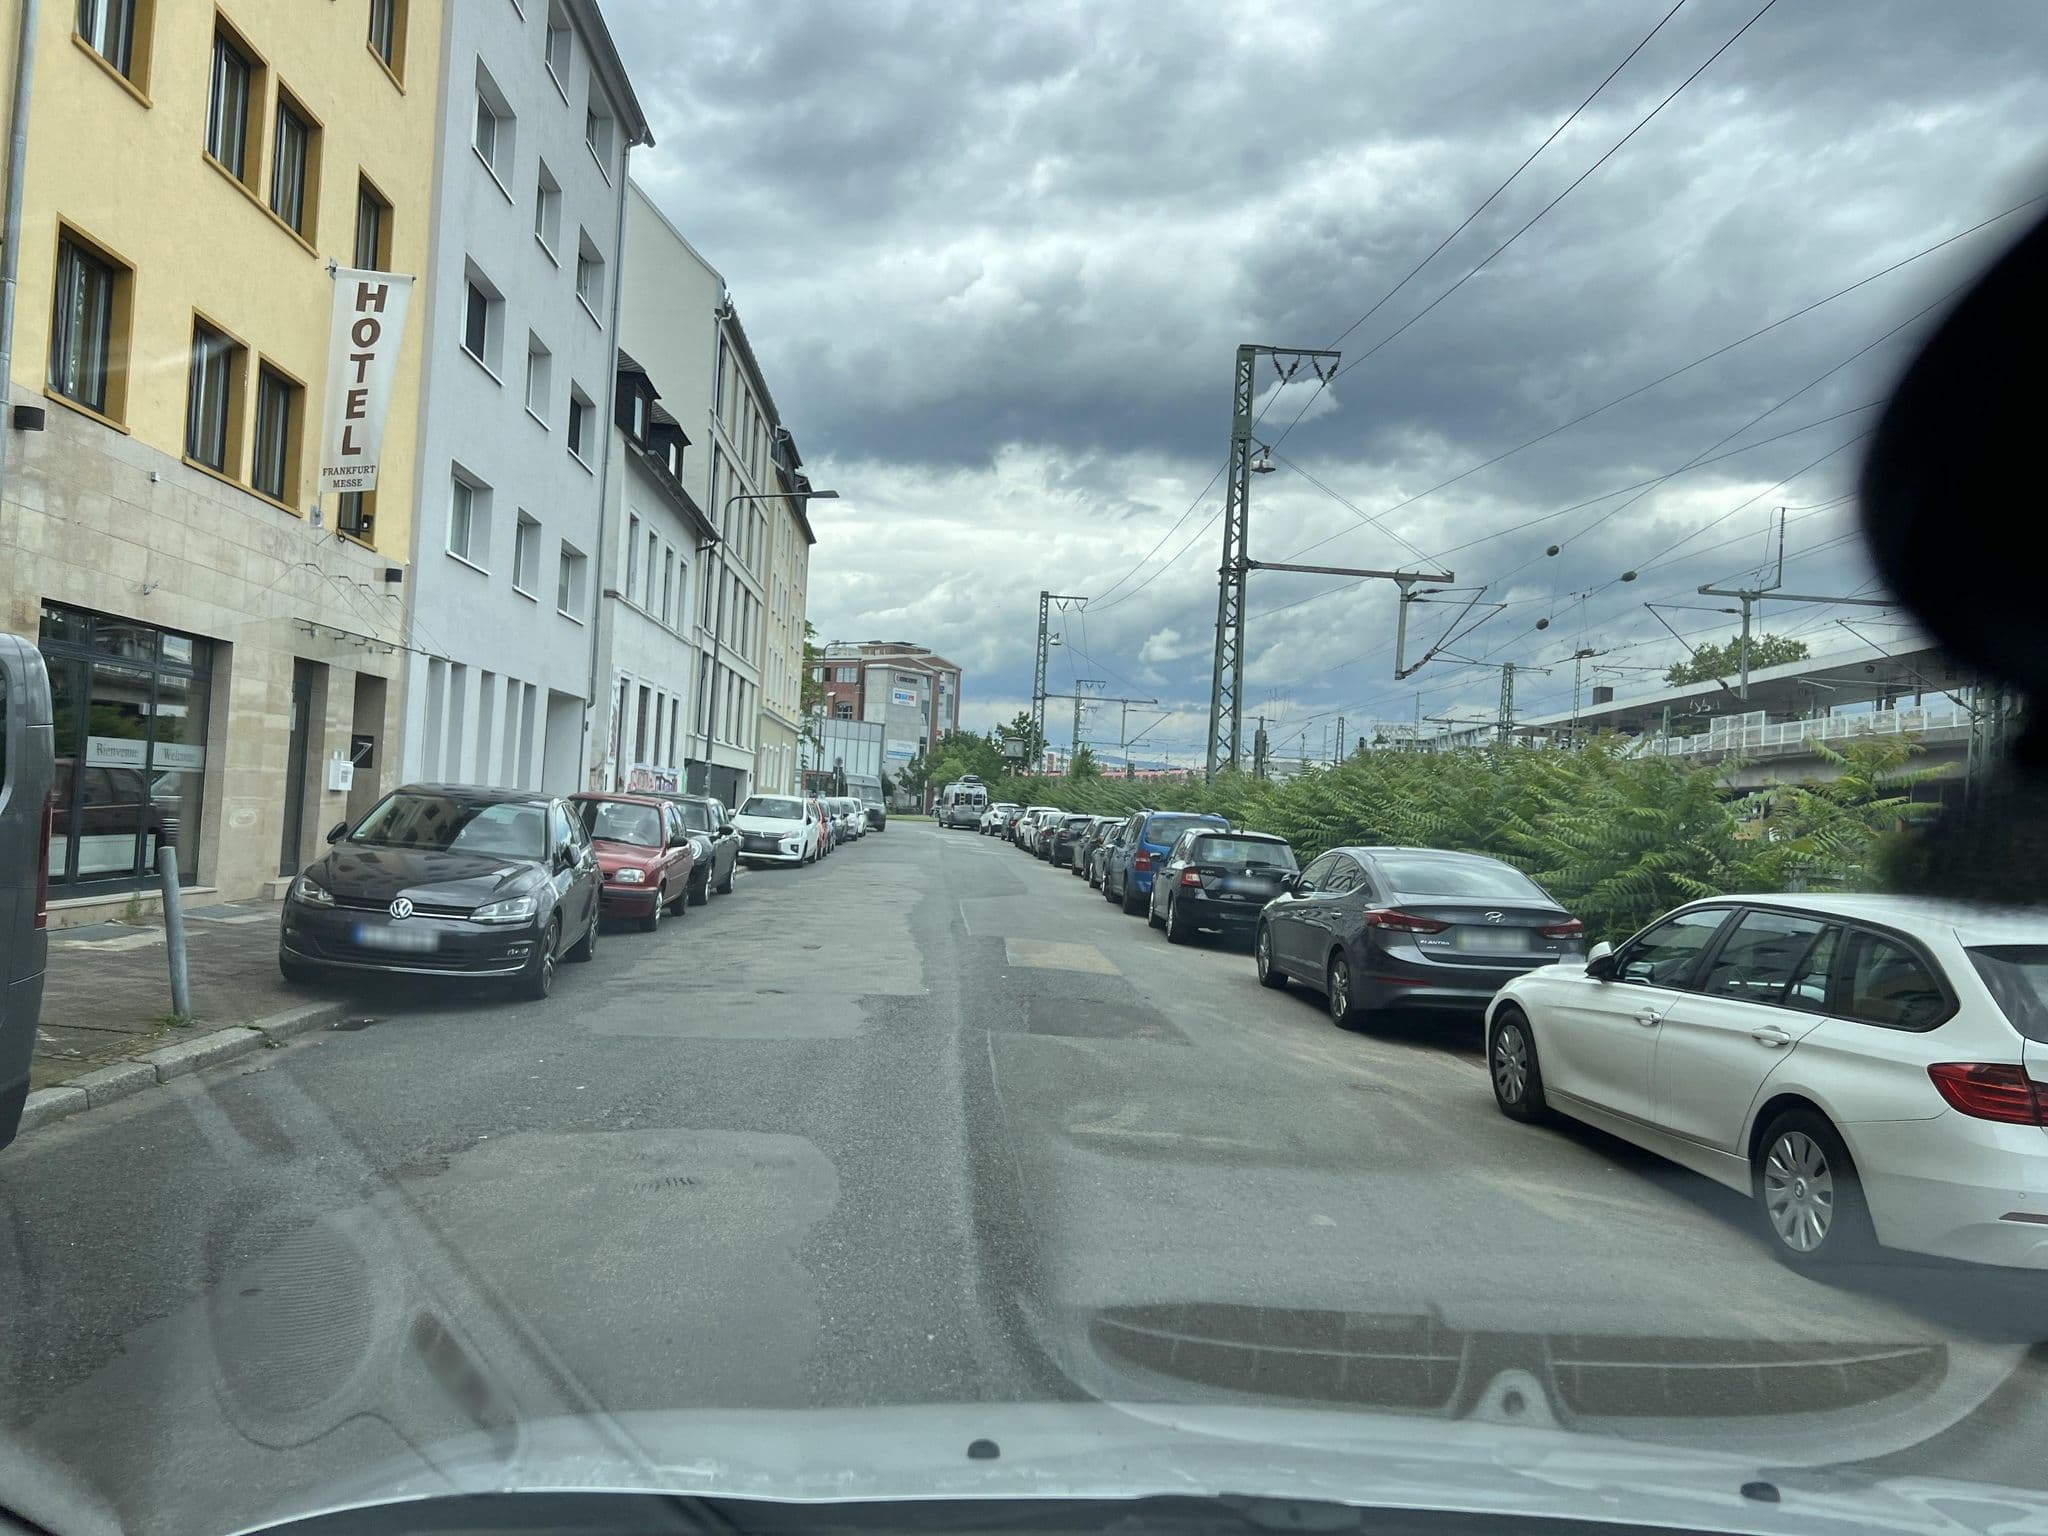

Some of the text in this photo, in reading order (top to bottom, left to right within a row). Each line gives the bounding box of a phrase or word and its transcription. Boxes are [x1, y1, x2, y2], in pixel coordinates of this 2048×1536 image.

[341, 281, 389, 456] HOTEL
[322, 465, 377, 476] FRANKFURT
[332, 478, 363, 489] MESSE
